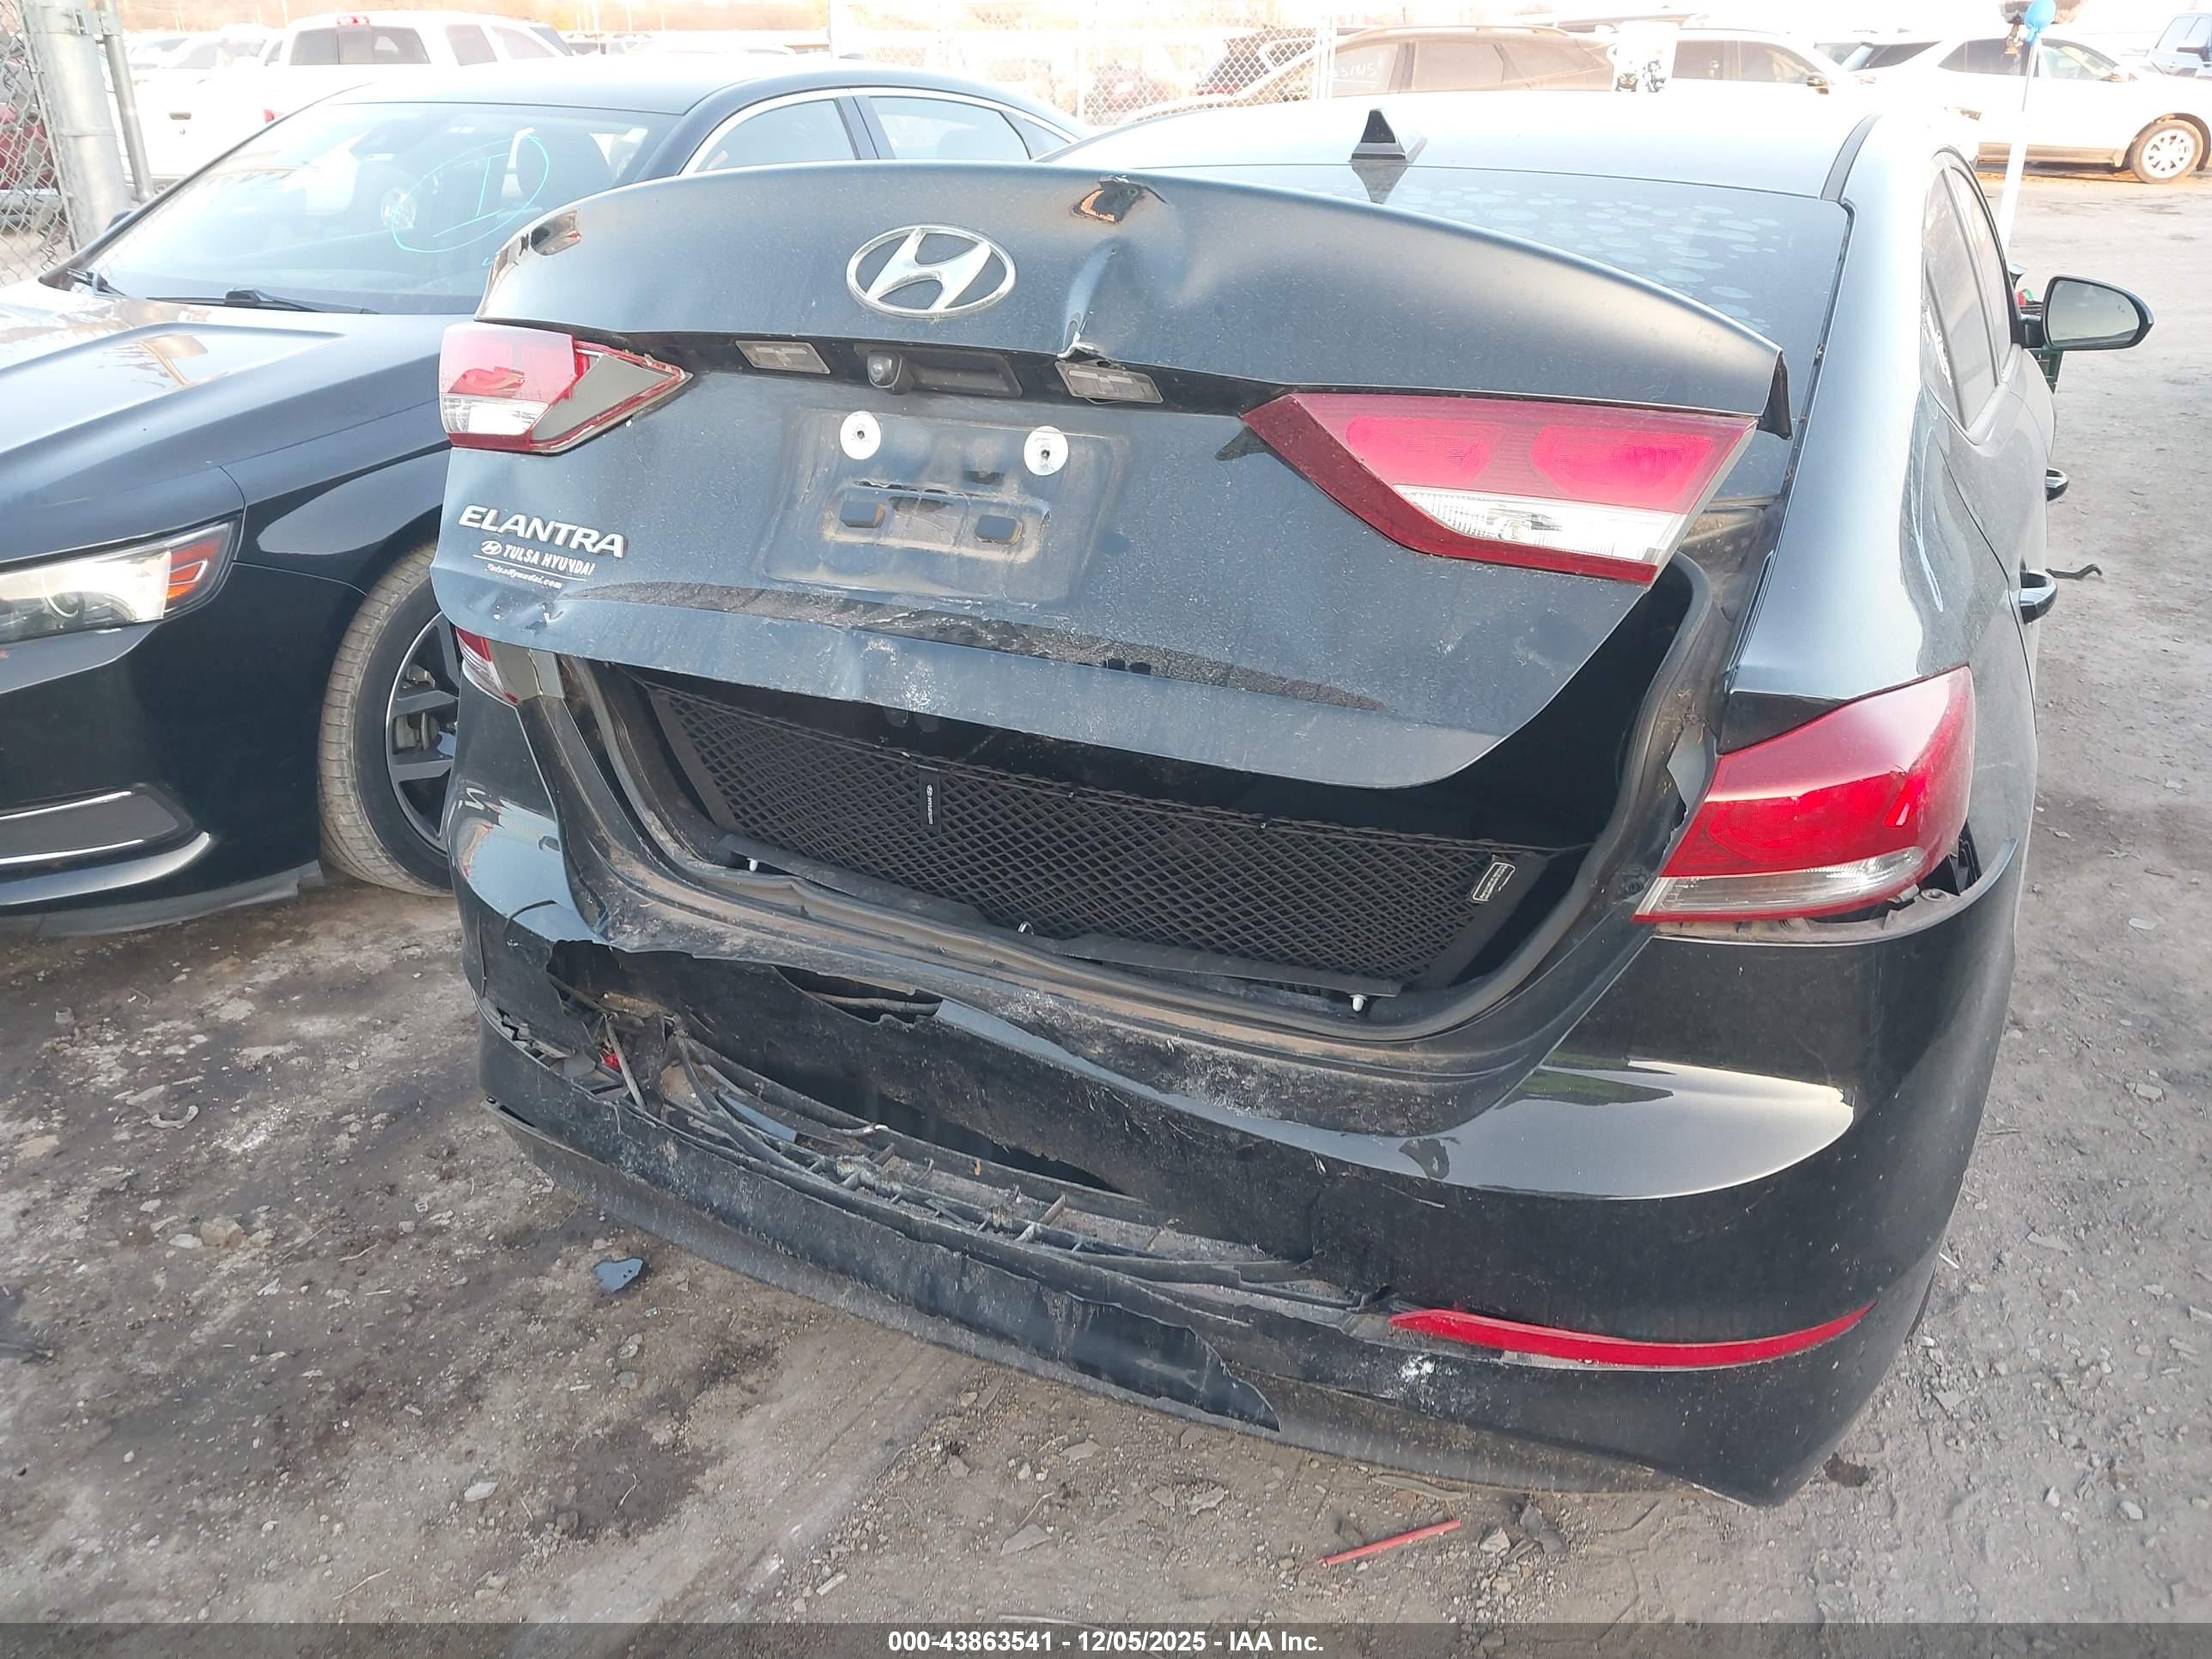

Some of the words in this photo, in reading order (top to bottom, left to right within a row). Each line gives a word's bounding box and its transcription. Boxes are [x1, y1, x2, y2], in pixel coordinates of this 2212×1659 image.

[459, 504, 626, 558] ELANTRA
[502, 544, 538, 565] TULSA
[540, 552, 596, 576] HYUNDAI
